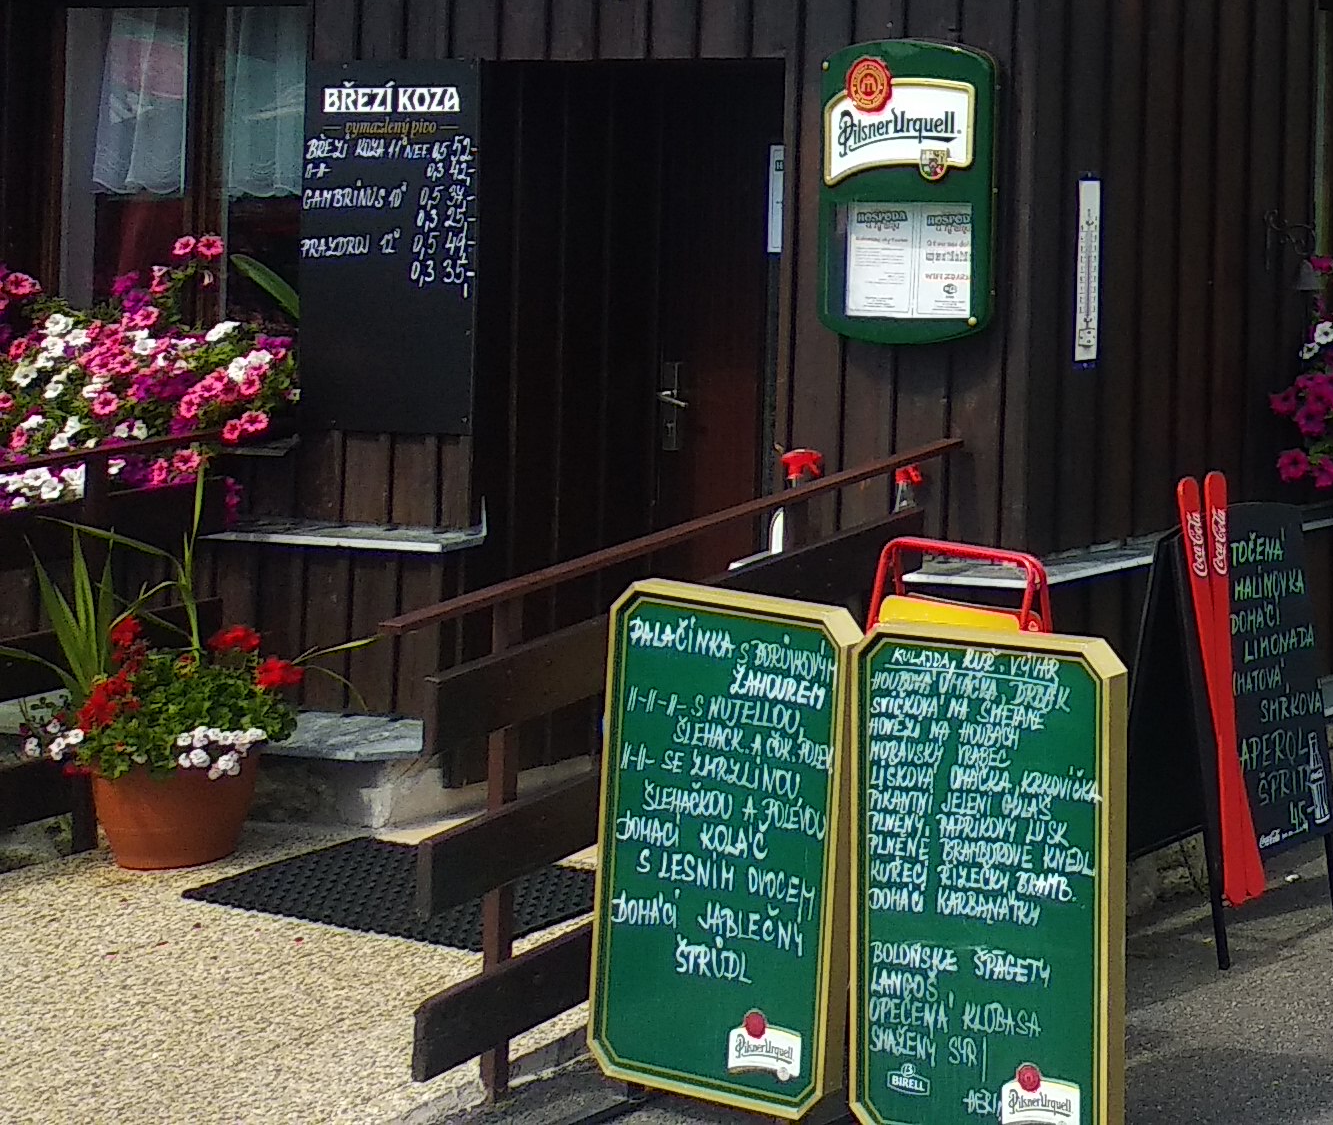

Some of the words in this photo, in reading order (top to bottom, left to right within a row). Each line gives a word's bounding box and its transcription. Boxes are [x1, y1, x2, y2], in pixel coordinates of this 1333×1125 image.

[323, 81, 395, 112] BŘEZÍ
[397, 87, 461, 112] KOZA
[411, 119, 437, 137] pivo
[838, 109, 893, 158] Pilsner
[891, 106, 955, 144] Urquell
[302, 179, 386, 210] GAMBRINUS
[1212, 505, 1228, 575] Coca-Cola
[691, 694, 704, 718] S
[947, 697, 970, 720] NA
[752, 733, 762, 756] A
[929, 718, 951, 743] NA
[661, 749, 685, 774] SE
[1239, 727, 1309, 776] APEROL
[642, 778, 733, 820] ŠLEHAČKOU
[742, 795, 758, 823] A
[700, 820, 769, 860] KOLÁČ
[636, 848, 651, 873] S
[748, 866, 816, 922] OVOCEM
[735, 1033, 767, 1059] Pilsner
[765, 1038, 794, 1062] Urquell
[891, 1076, 926, 1092] BIRELL
[1008, 1088, 1042, 1115] Pilsner
[1039, 1092, 1072, 1116] Urquell
